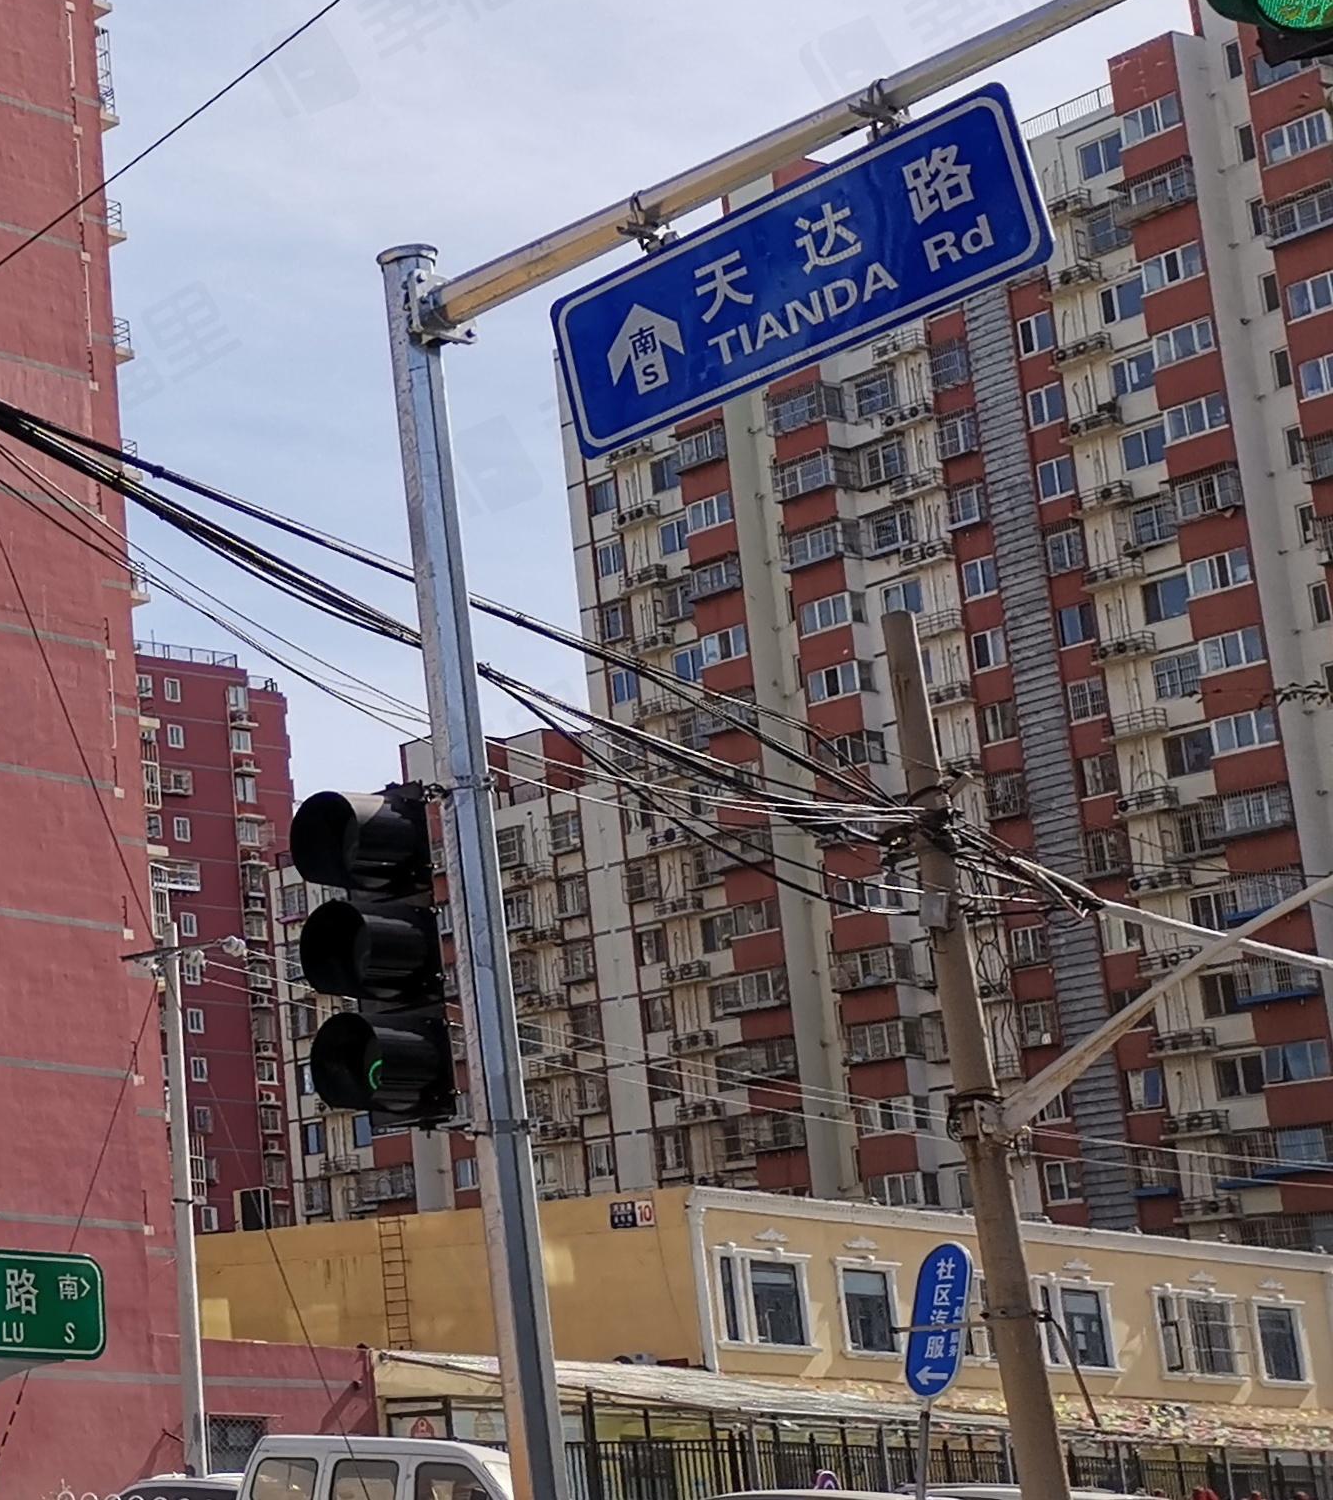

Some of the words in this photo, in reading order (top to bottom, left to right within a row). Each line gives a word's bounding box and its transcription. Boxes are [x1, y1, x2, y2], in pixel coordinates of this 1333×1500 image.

[694, 143, 975, 324] 天达路
[707, 261, 899, 367] TIANDA
[922, 215, 996, 273] Rd
[628, 325, 660, 358] 南
[642, 367, 661, 388] S
[637, 1204, 652, 1222] 10
[57, 1272, 80, 1302] 南
[1, 1320, 25, 1344] LU
[63, 1321, 76, 1345] S
